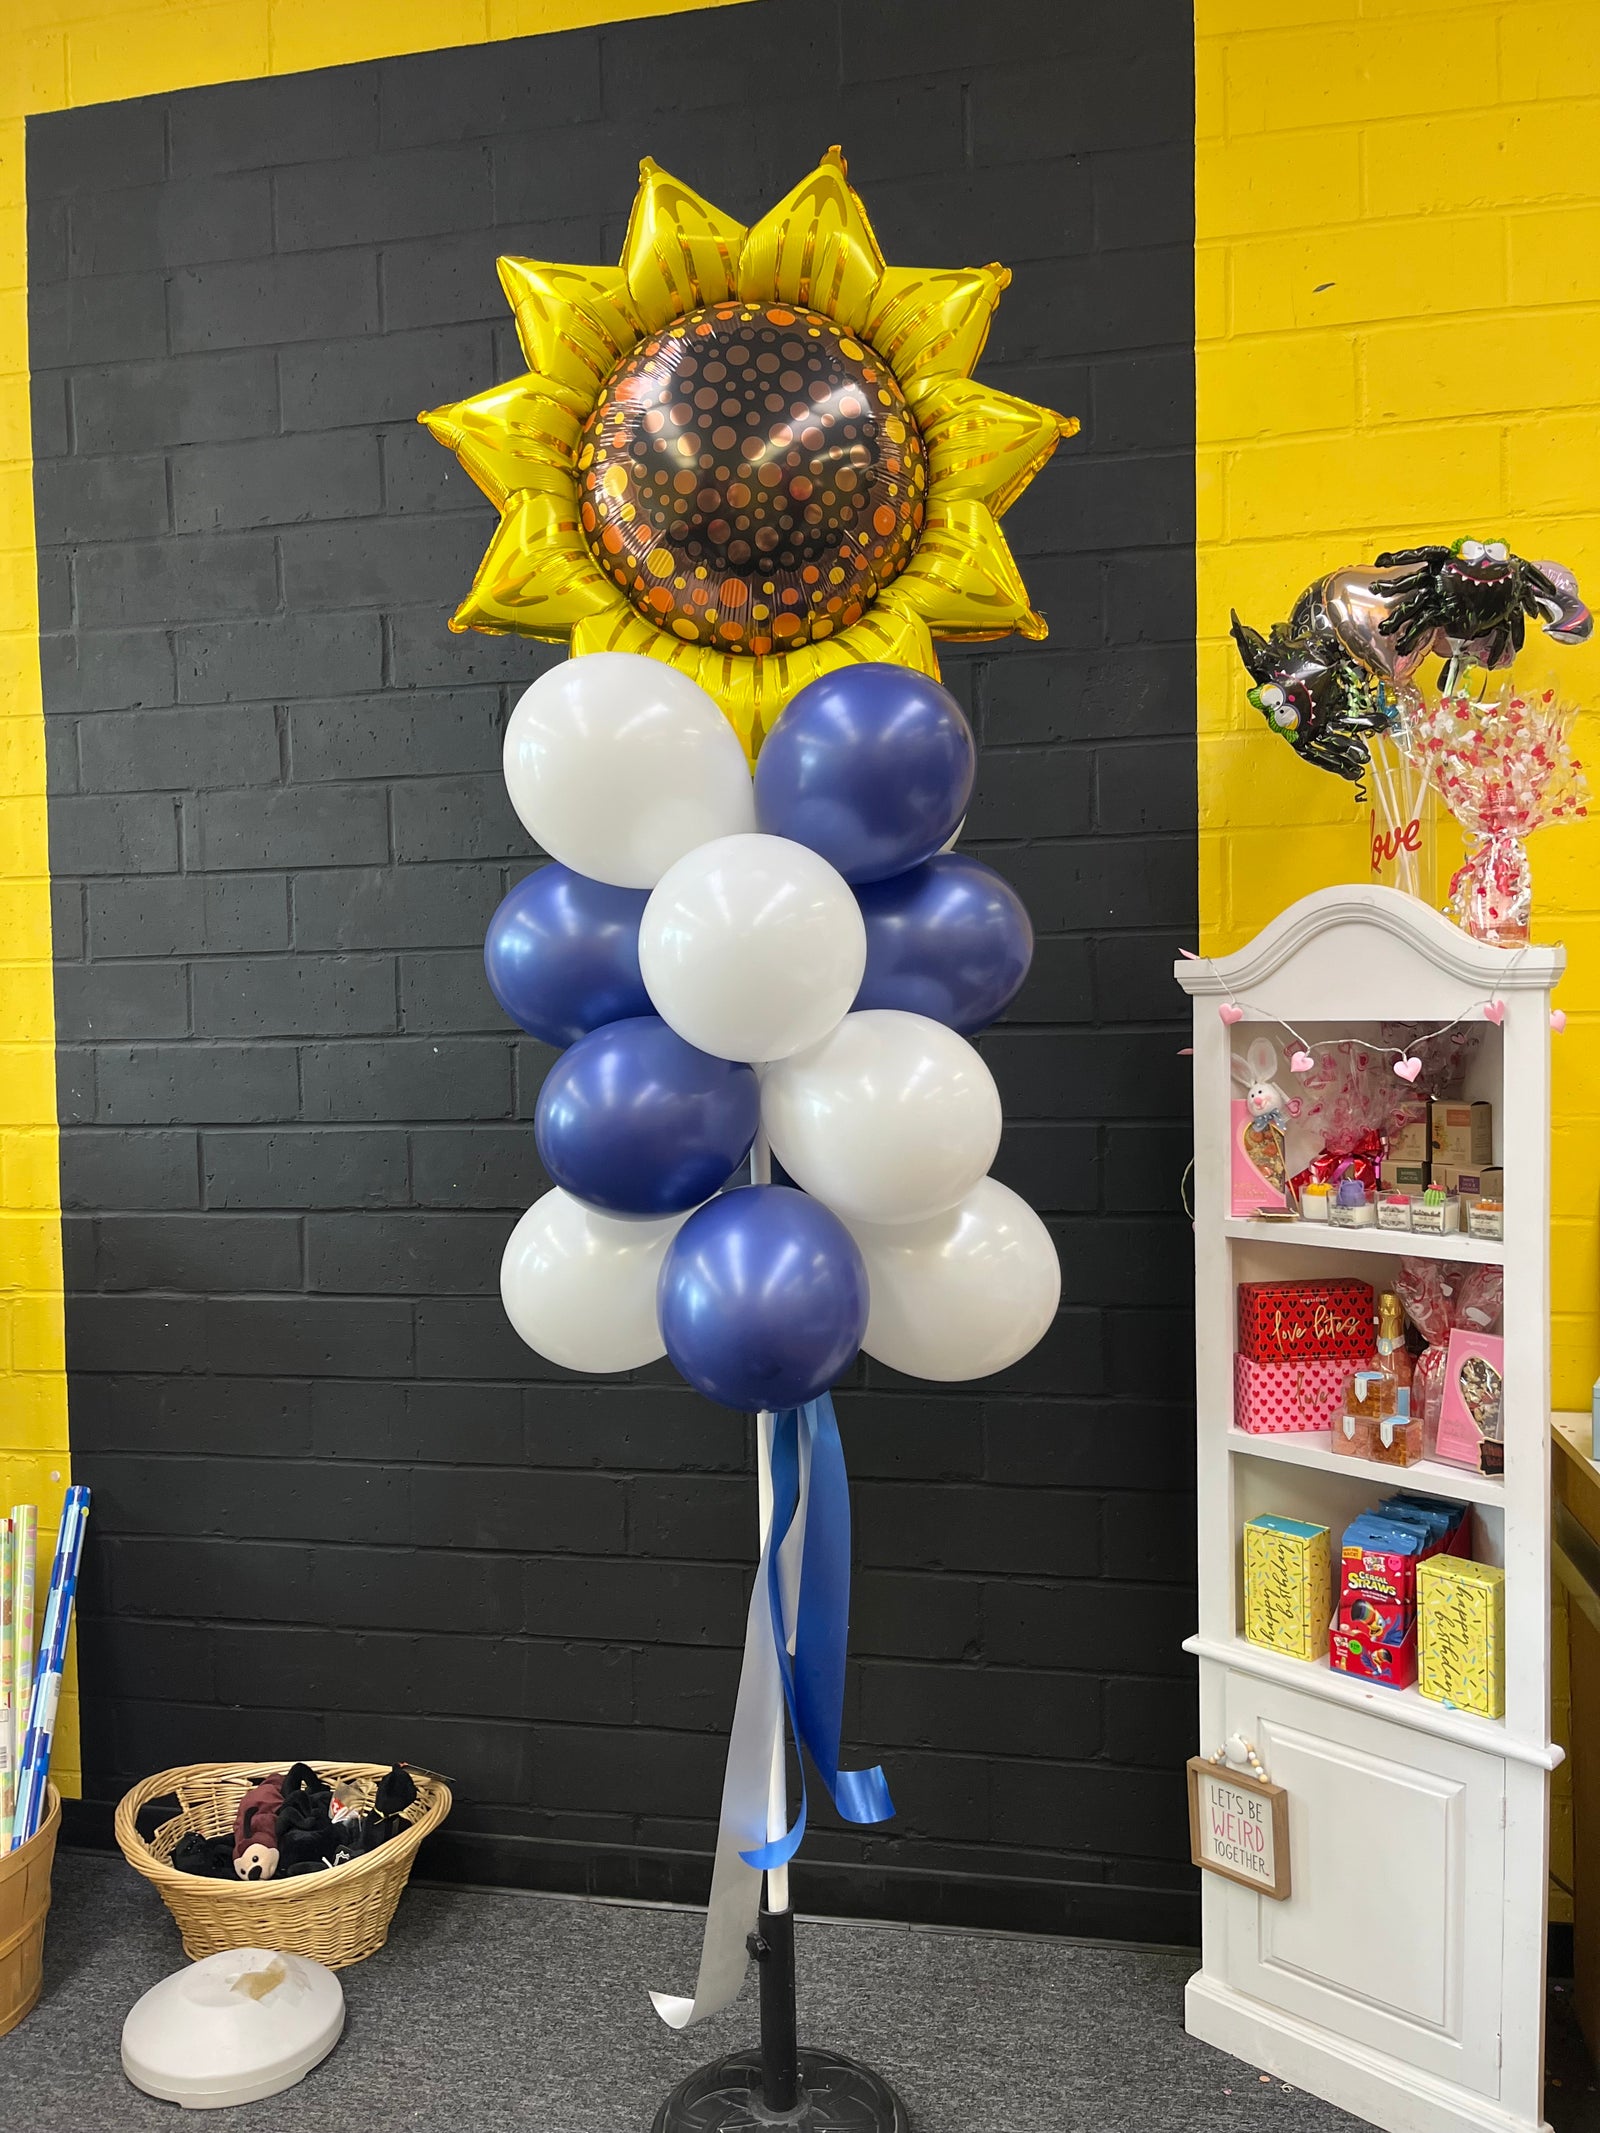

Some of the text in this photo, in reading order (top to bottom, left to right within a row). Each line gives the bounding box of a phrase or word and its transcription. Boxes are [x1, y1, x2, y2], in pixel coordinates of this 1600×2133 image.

[1370, 808, 1422, 874] love
[1272, 1305, 1360, 1356] love bites
[1295, 1370, 1330, 1419] love
[1270, 1540, 1295, 1619] birthday
[1348, 1572, 1396, 1596] STRAWS
[1358, 1571, 1388, 1584] CEREAL
[1260, 1583, 1280, 1642] happy
[1450, 1585, 1474, 1649] happy
[1433, 1610, 1461, 1697] birthday
[1211, 1785, 1263, 1823] LET'S BE
[1212, 1807, 1264, 1852] WEIRD
